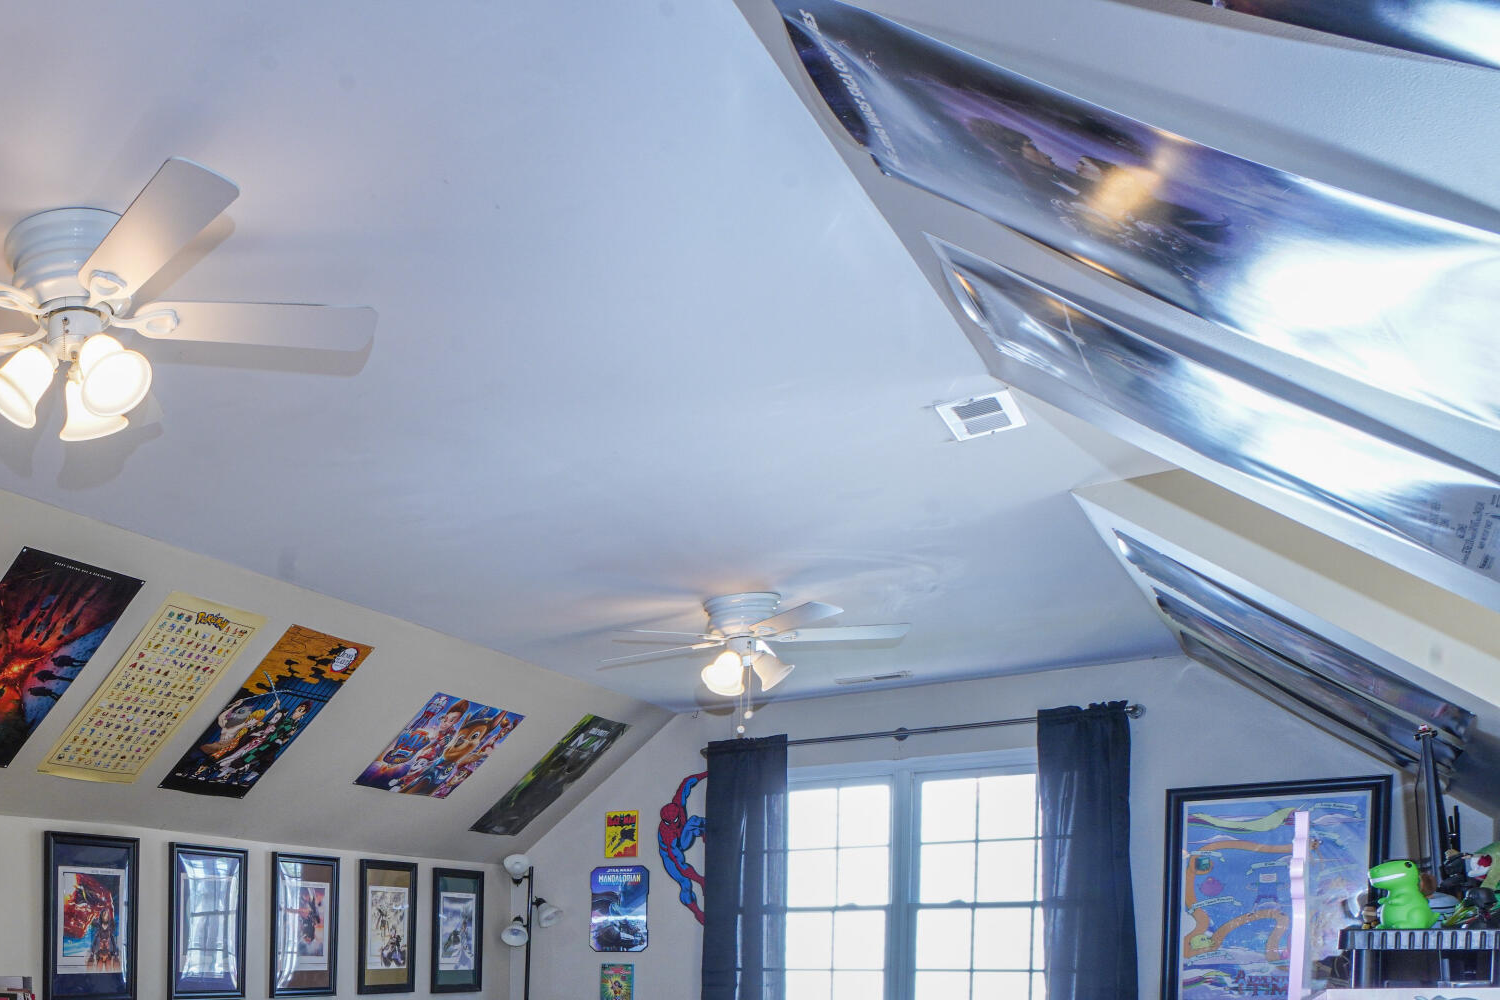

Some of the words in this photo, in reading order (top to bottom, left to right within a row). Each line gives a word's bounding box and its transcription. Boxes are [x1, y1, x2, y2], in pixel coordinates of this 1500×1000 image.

[599, 874, 641, 883] MANDALORIAN
[1232, 969, 1289, 985] ADVENT
[1246, 984, 1289, 997] TIM
